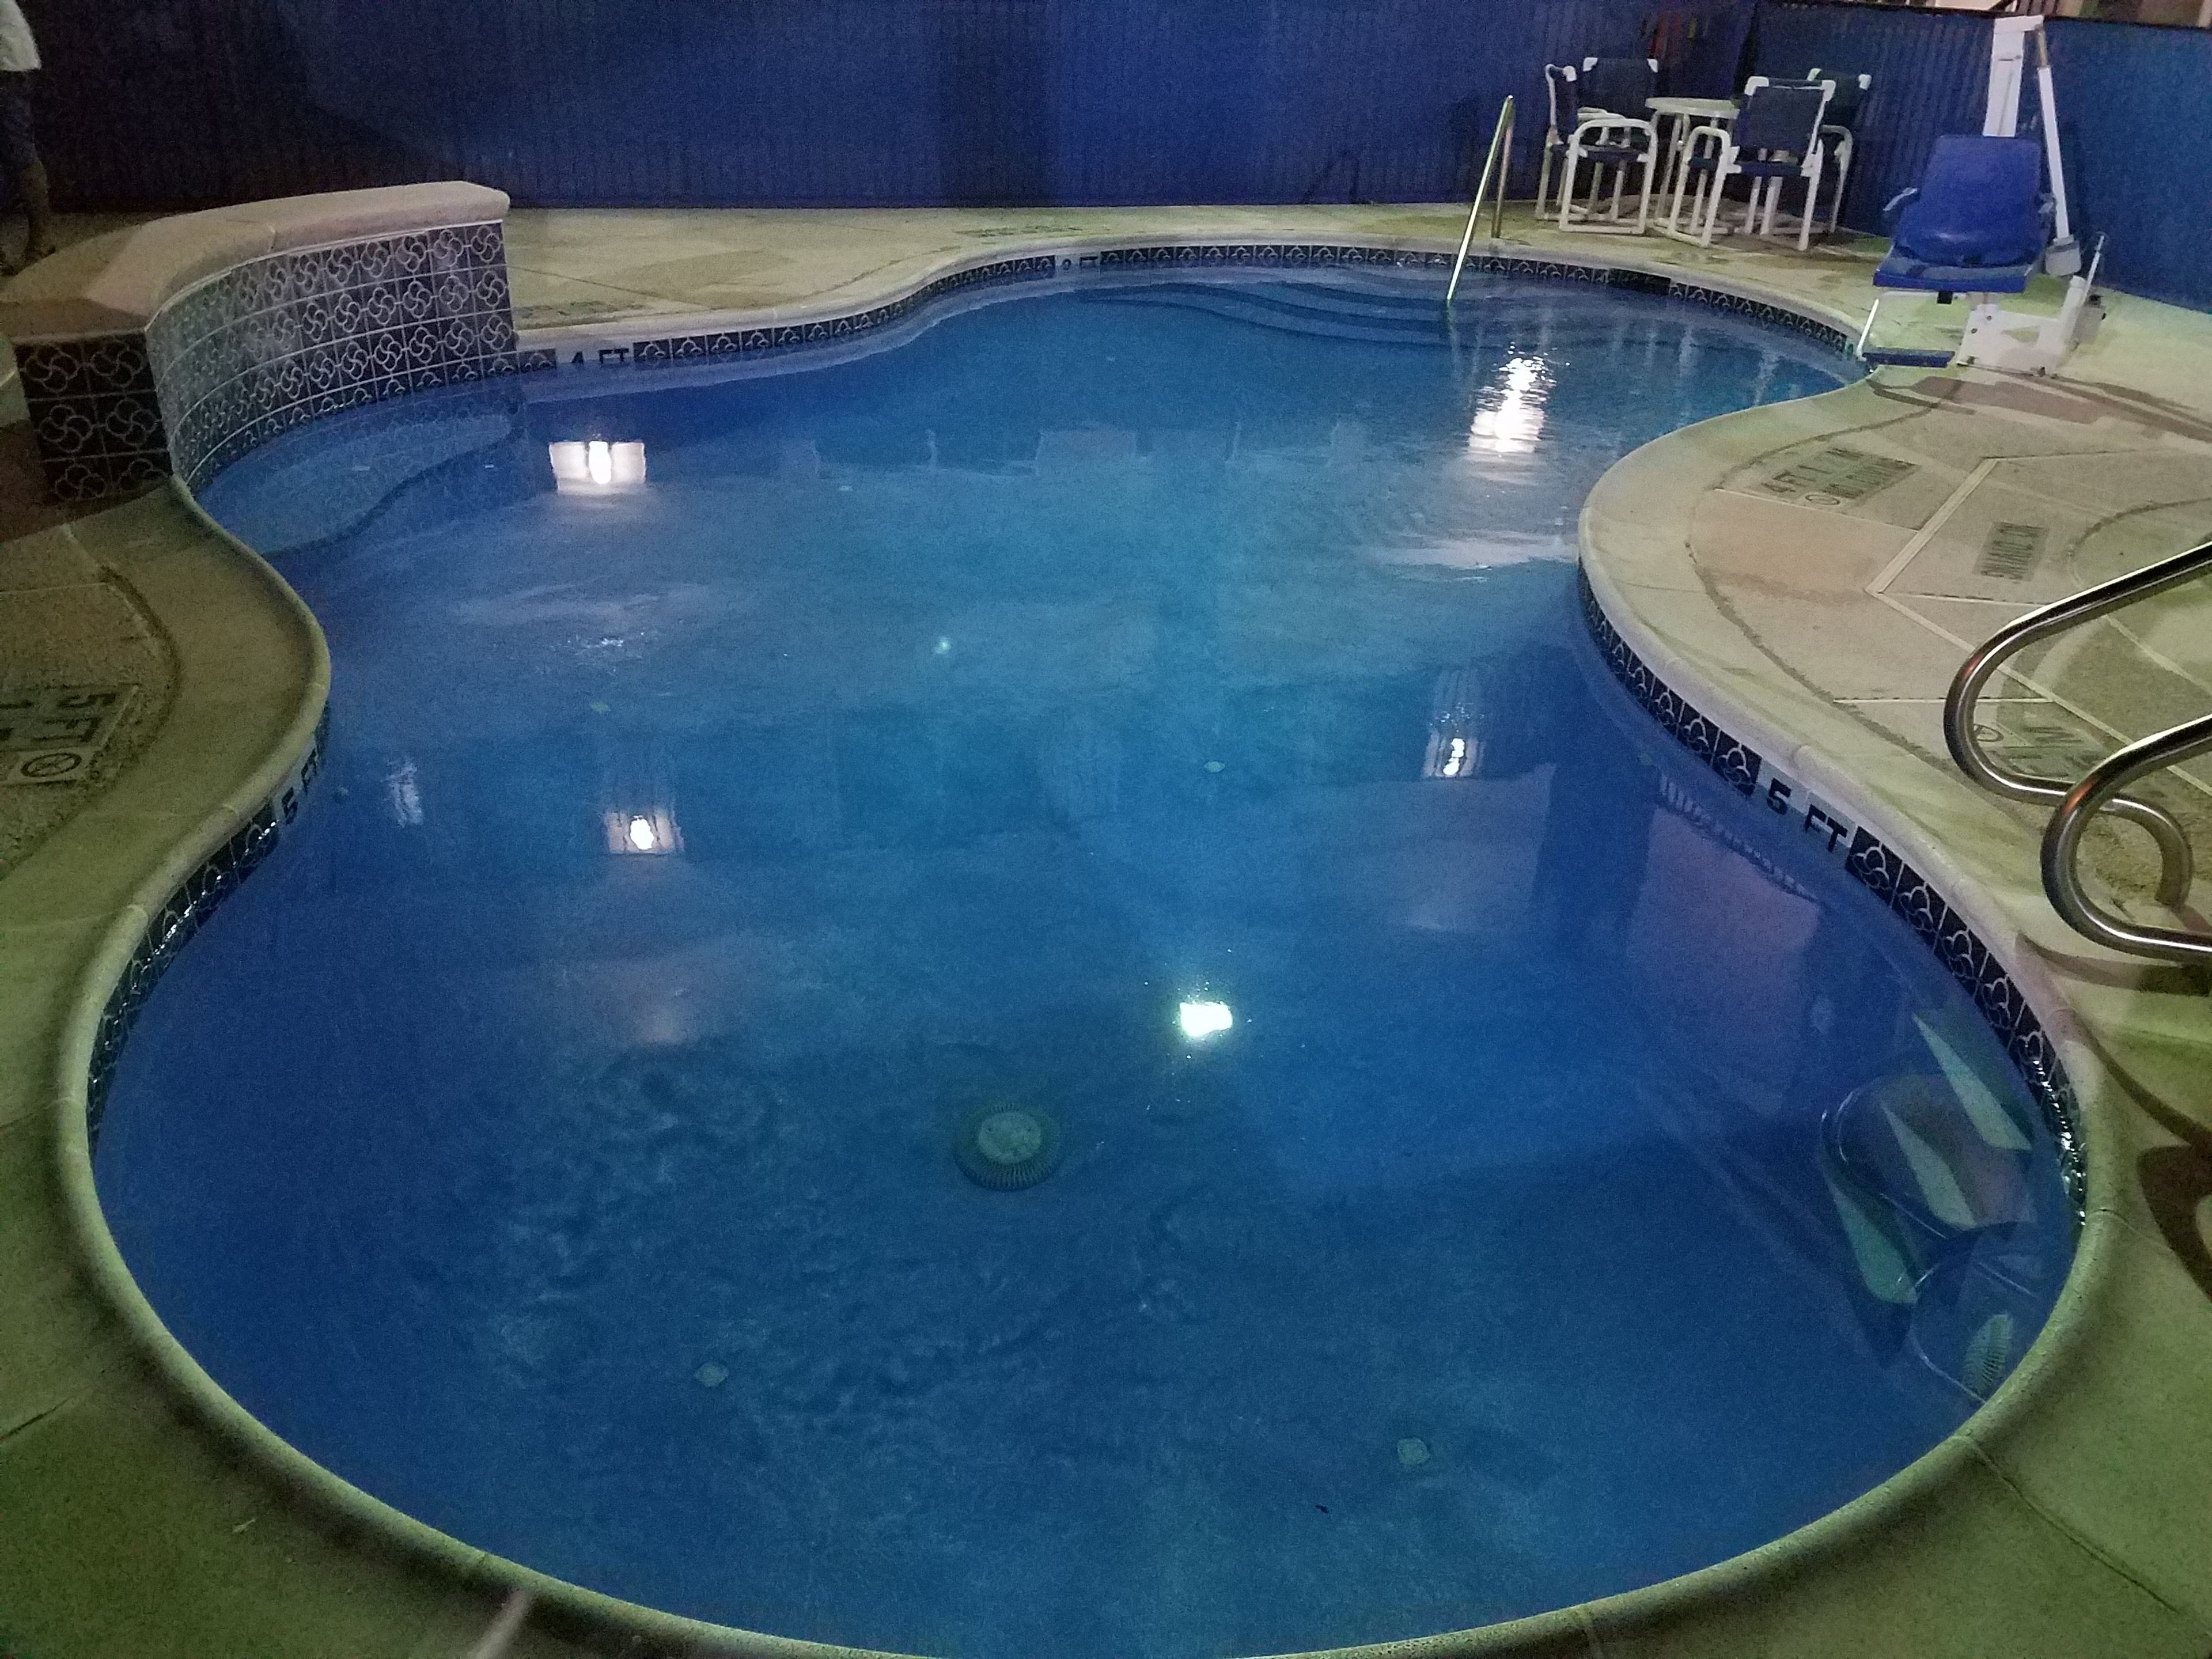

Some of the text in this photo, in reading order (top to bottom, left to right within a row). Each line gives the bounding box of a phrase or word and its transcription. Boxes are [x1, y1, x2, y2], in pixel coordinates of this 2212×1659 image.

[282, 748, 317, 825] 5 FT
[1767, 778, 1848, 853] 5 FT
